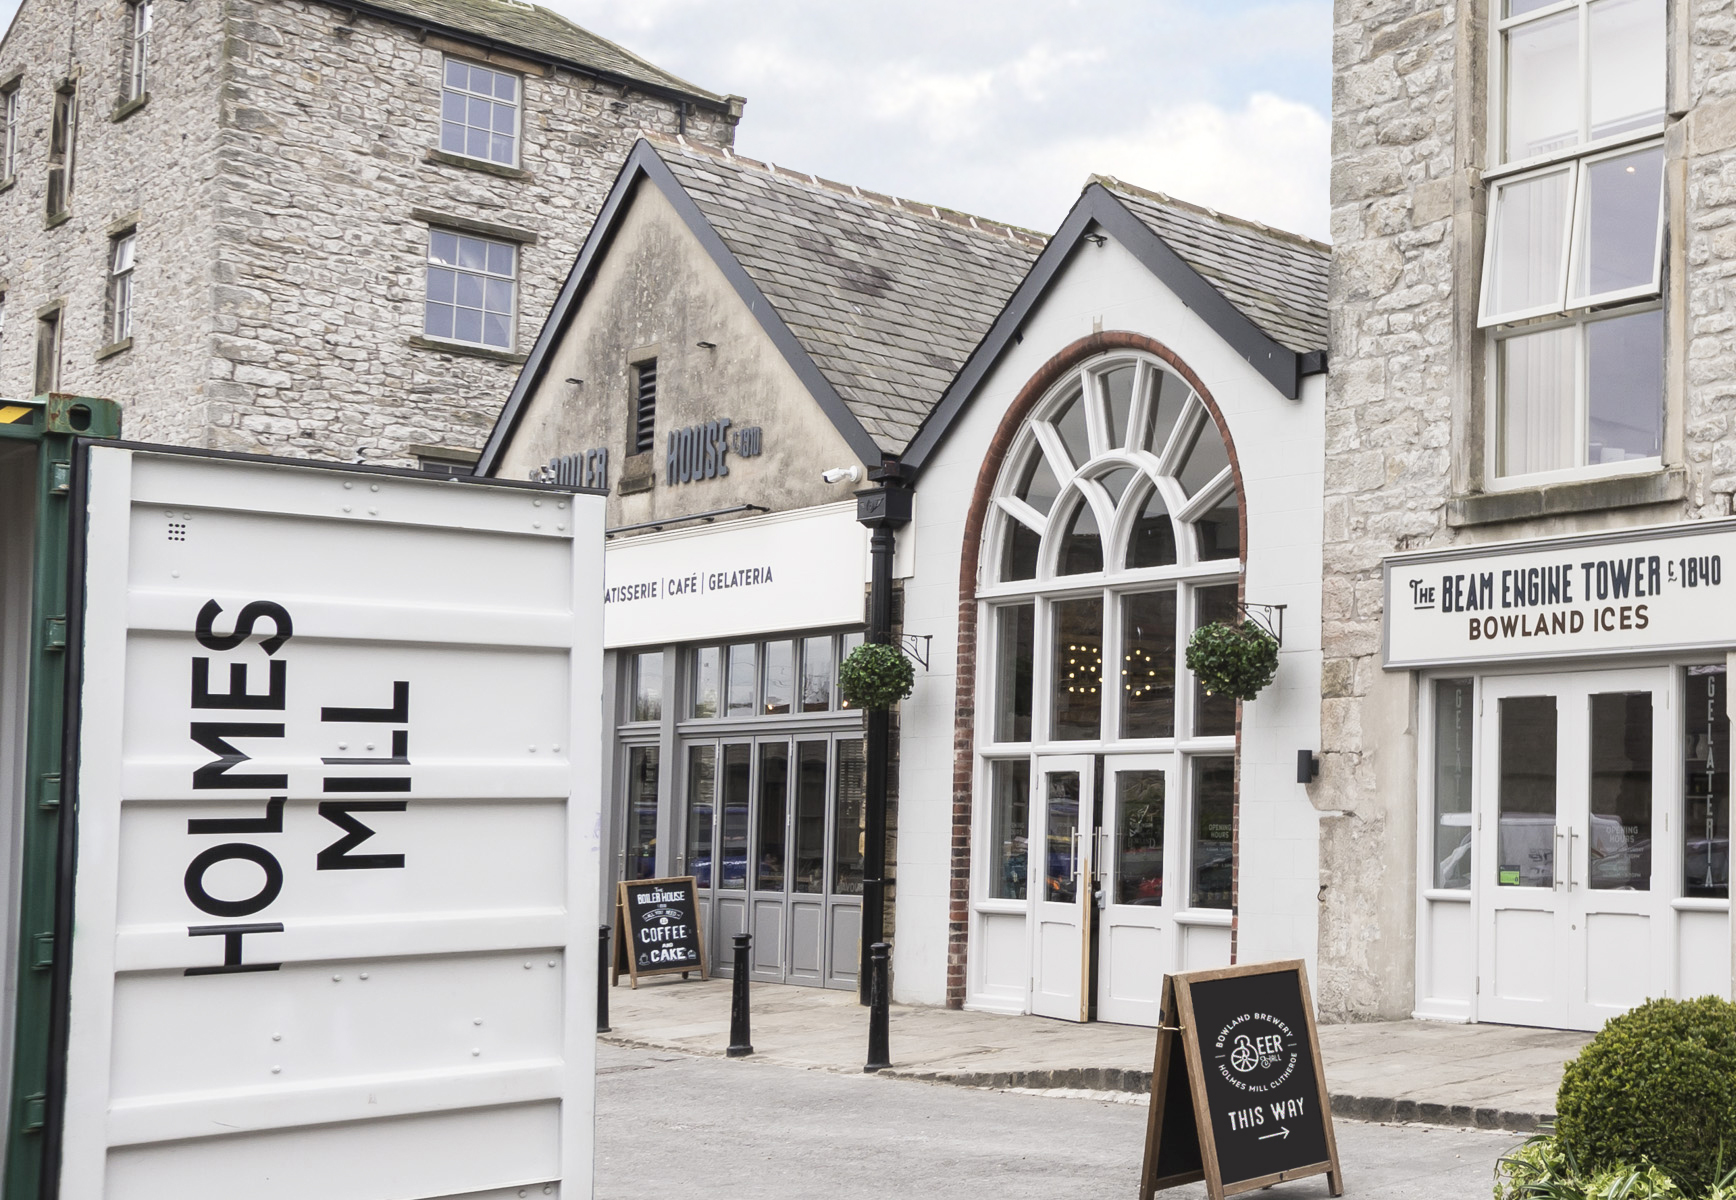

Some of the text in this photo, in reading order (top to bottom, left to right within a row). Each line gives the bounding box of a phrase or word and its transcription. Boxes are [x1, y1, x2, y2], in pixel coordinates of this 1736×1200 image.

[666, 418, 730, 486] HOUSE
[604, 566, 773, 604] ATISSERIE CAFÉ GELATERIA
[1409, 578, 1435, 610] THE
[1442, 572, 1494, 613] BEAM
[1501, 564, 1573, 608] ENGINE
[1581, 555, 1660, 601] TOWER
[1679, 555, 1721, 588] 1840
[1469, 605, 1649, 640] BOWLAND ICES
[184, 598, 292, 977] HOLMES
[317, 681, 411, 871] MILL
[1706, 676, 1715, 888] GELATERIA
[1208, 823, 1232, 831] OPENING
[1210, 831, 1230, 839] HOURS
[1605, 825, 1639, 834] OPENING
[1609, 834, 1635, 843] HOURS
[637, 890, 686, 905] BOILER HOUSE
[641, 925, 687, 943] COFFEE
[650, 947, 687, 963] CAKE
[1216, 1012, 1293, 1049] BOWLAND BREWERY
[1231, 1034, 1283, 1072] BEER
[1218, 1052, 1298, 1093] HOLMES MILL CLITHEROE
[1228, 1097, 1304, 1131] THIS WAY
